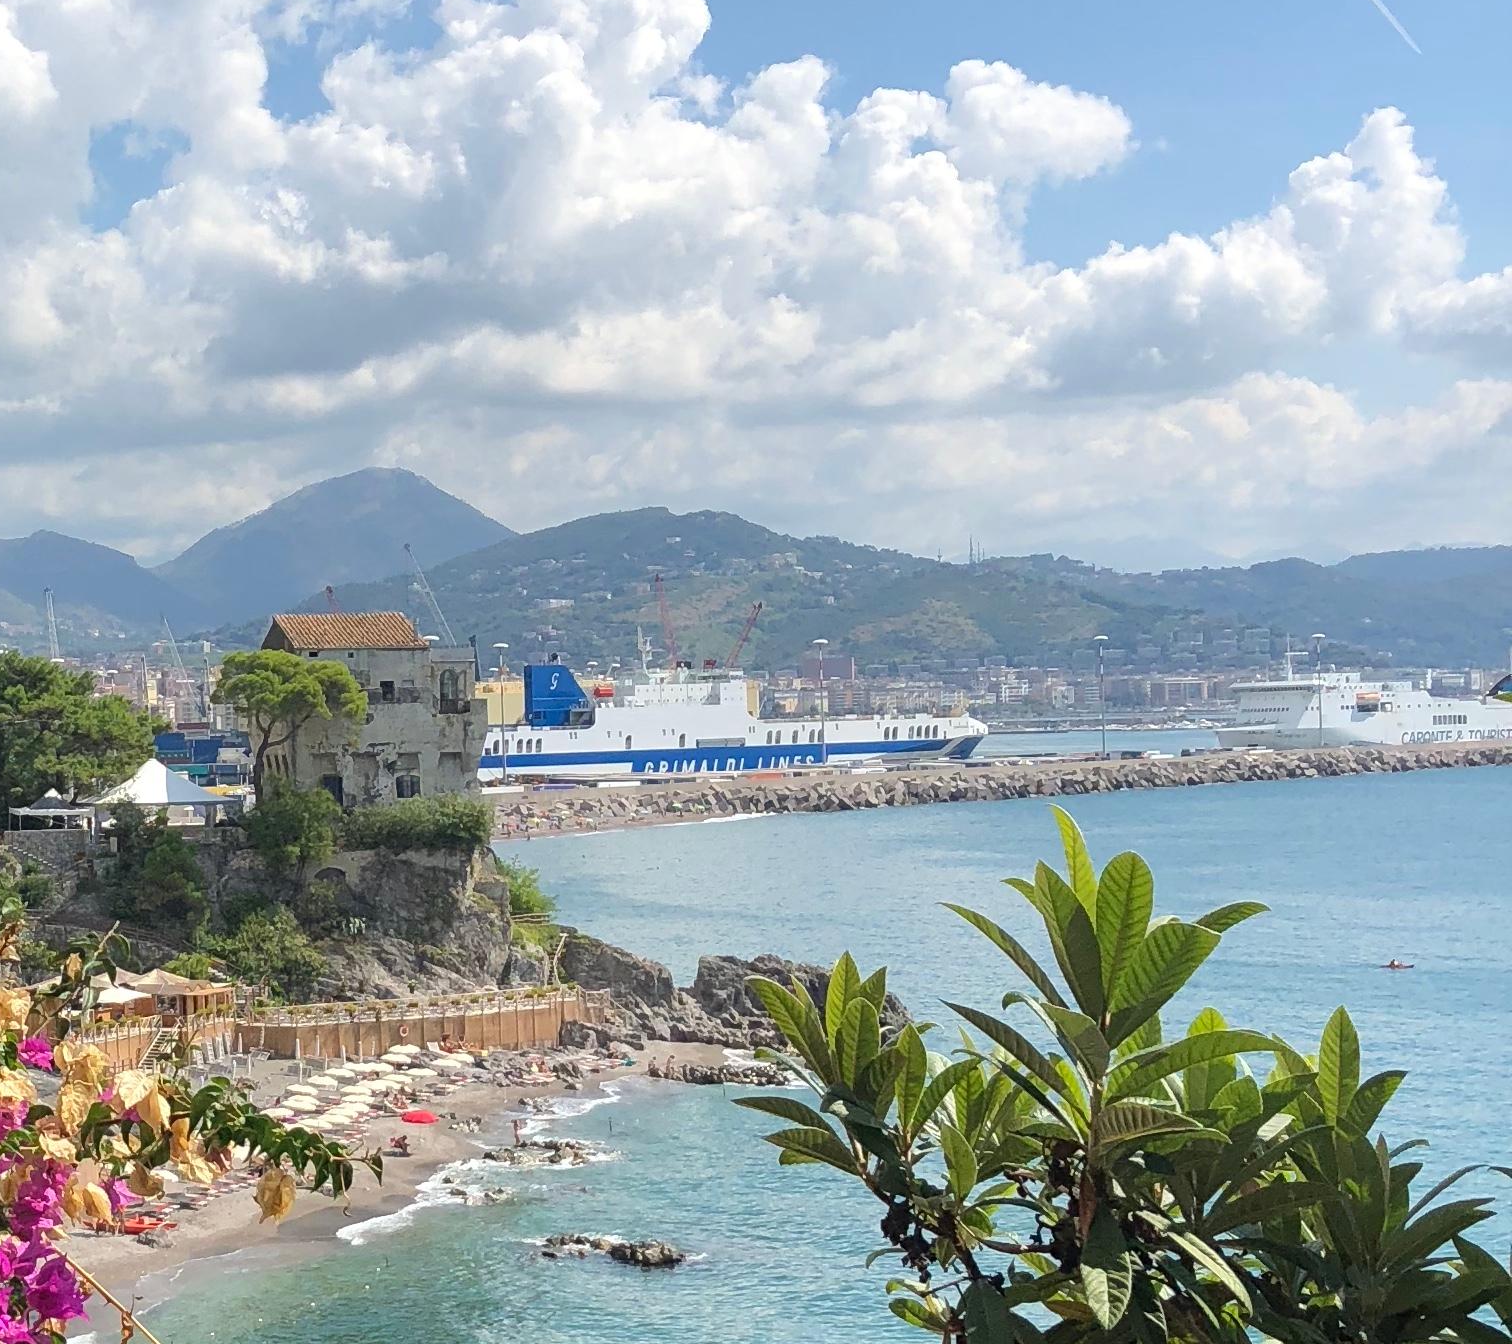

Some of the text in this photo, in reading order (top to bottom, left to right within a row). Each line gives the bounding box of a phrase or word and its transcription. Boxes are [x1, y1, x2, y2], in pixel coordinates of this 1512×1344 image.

[1456, 729, 1464, 741] &
[644, 755, 815, 773] GRIMALDI LINES
